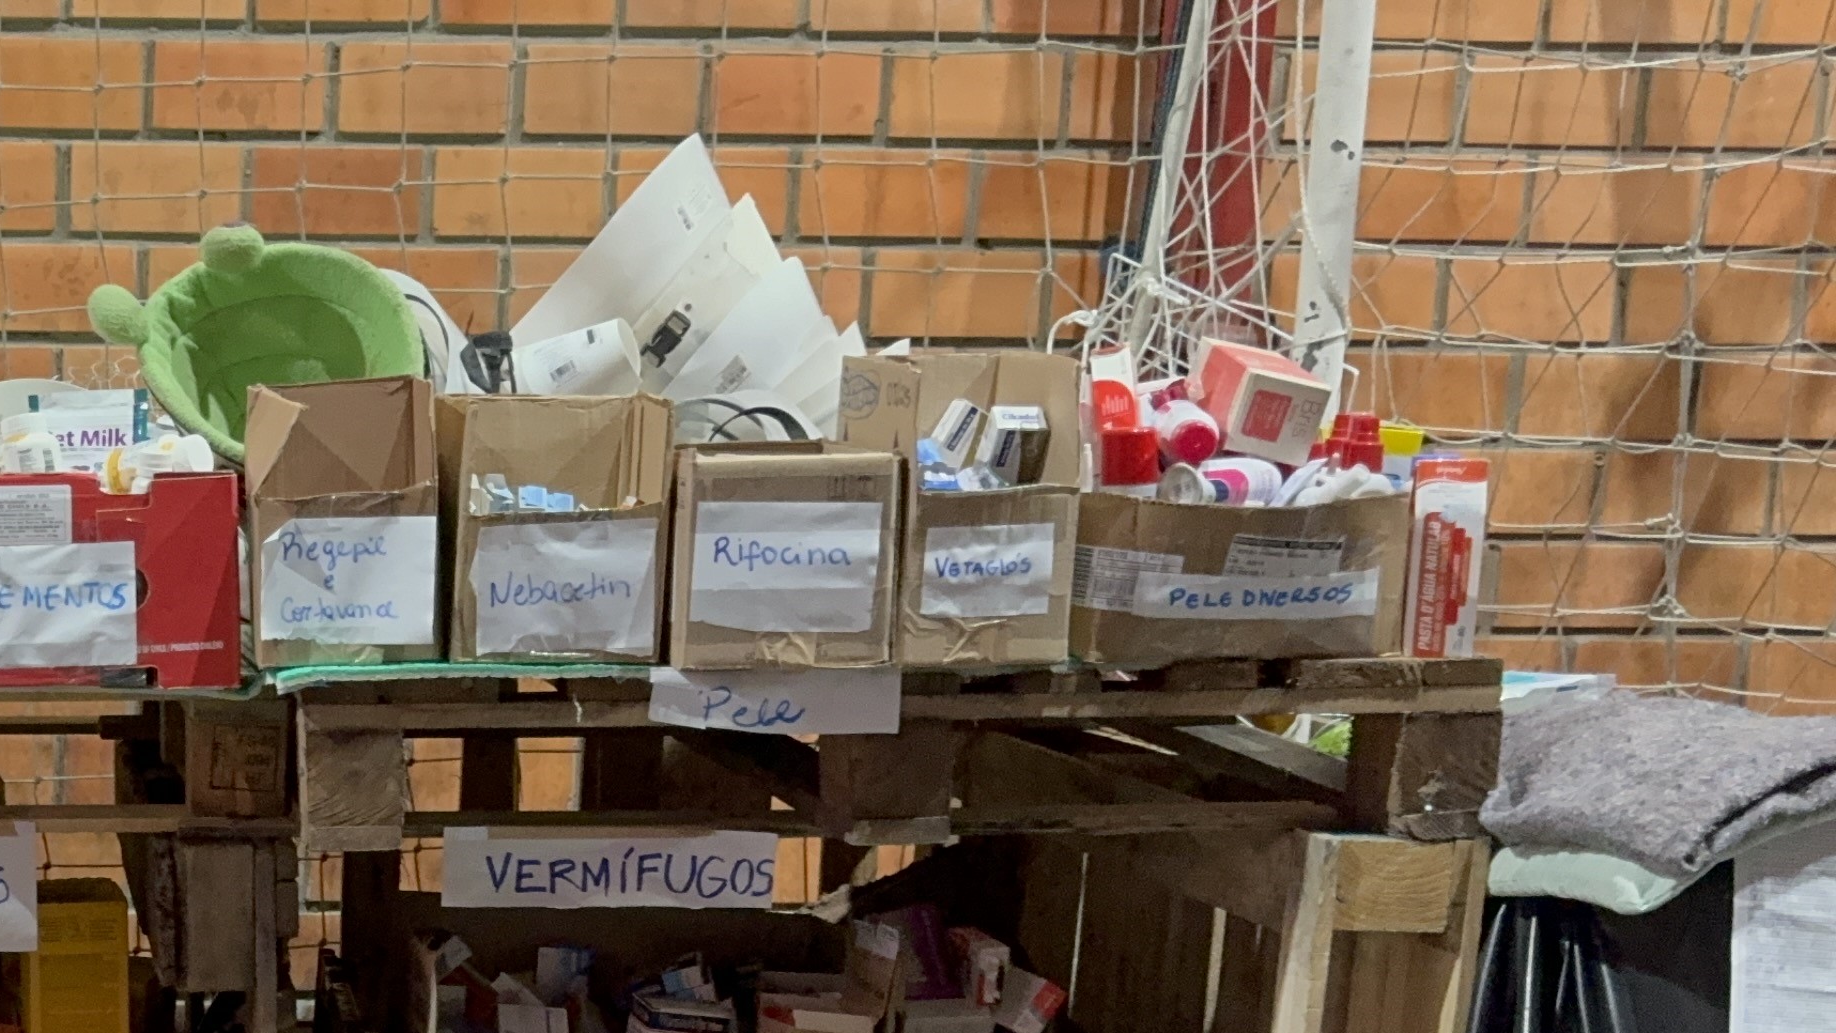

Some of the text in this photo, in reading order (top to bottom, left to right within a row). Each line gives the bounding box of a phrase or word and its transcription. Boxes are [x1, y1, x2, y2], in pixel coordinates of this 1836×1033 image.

[52, 428, 127, 448] et Milk
[713, 535, 852, 572] Rifocina
[1169, 587, 1233, 610] PELE
[1417, 616, 1433, 651] PASTA
[701, 685, 806, 727] Pele
[485, 846, 775, 899] VERMÍFUGOS
